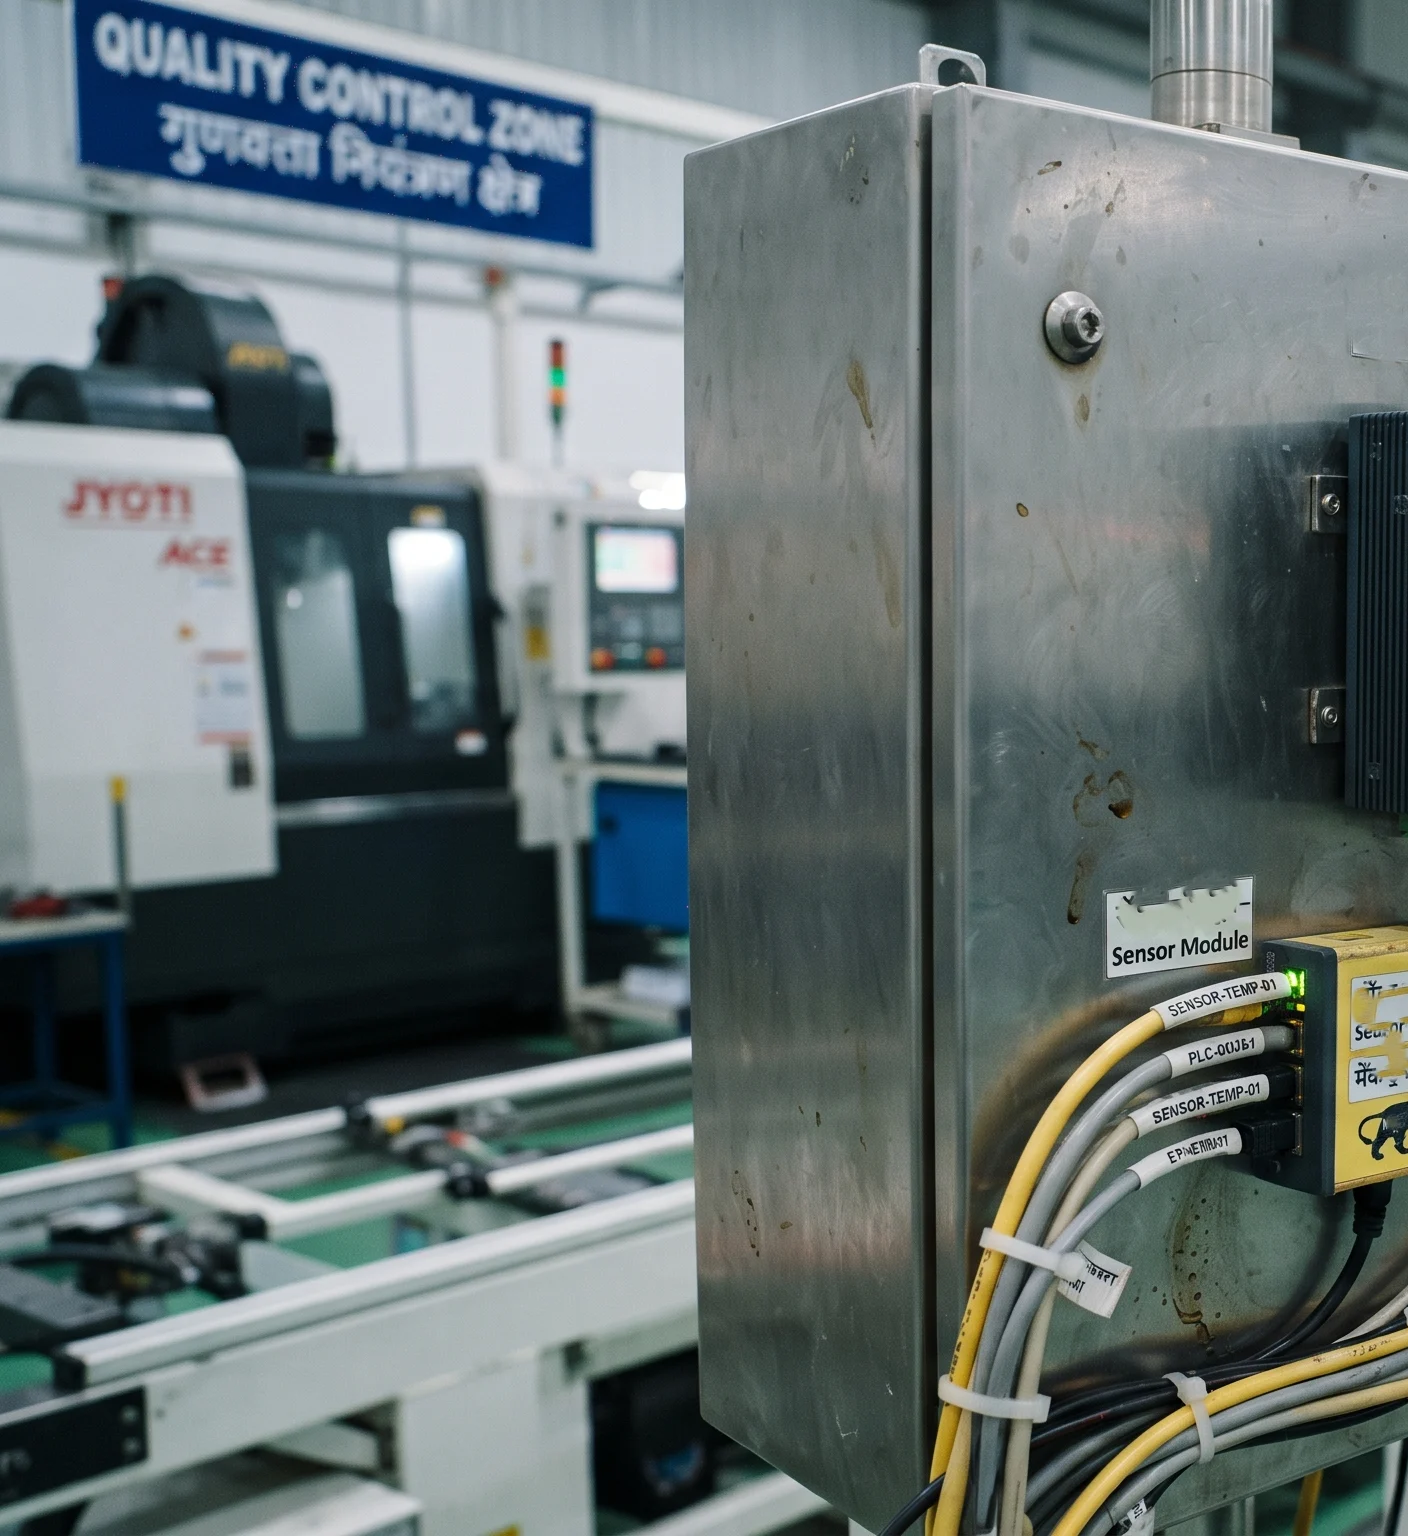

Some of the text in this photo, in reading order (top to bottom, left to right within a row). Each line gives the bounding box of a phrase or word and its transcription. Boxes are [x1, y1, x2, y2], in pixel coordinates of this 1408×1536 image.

[94, 12, 583, 166] QUALITY CONTROL ZONE
[66, 480, 193, 520] JYOTI
[157, 538, 231, 569] ACE
[1112, 929, 1249, 967] Sensor Module
[1168, 979, 1277, 1017] SENSOR-TEMP-01
